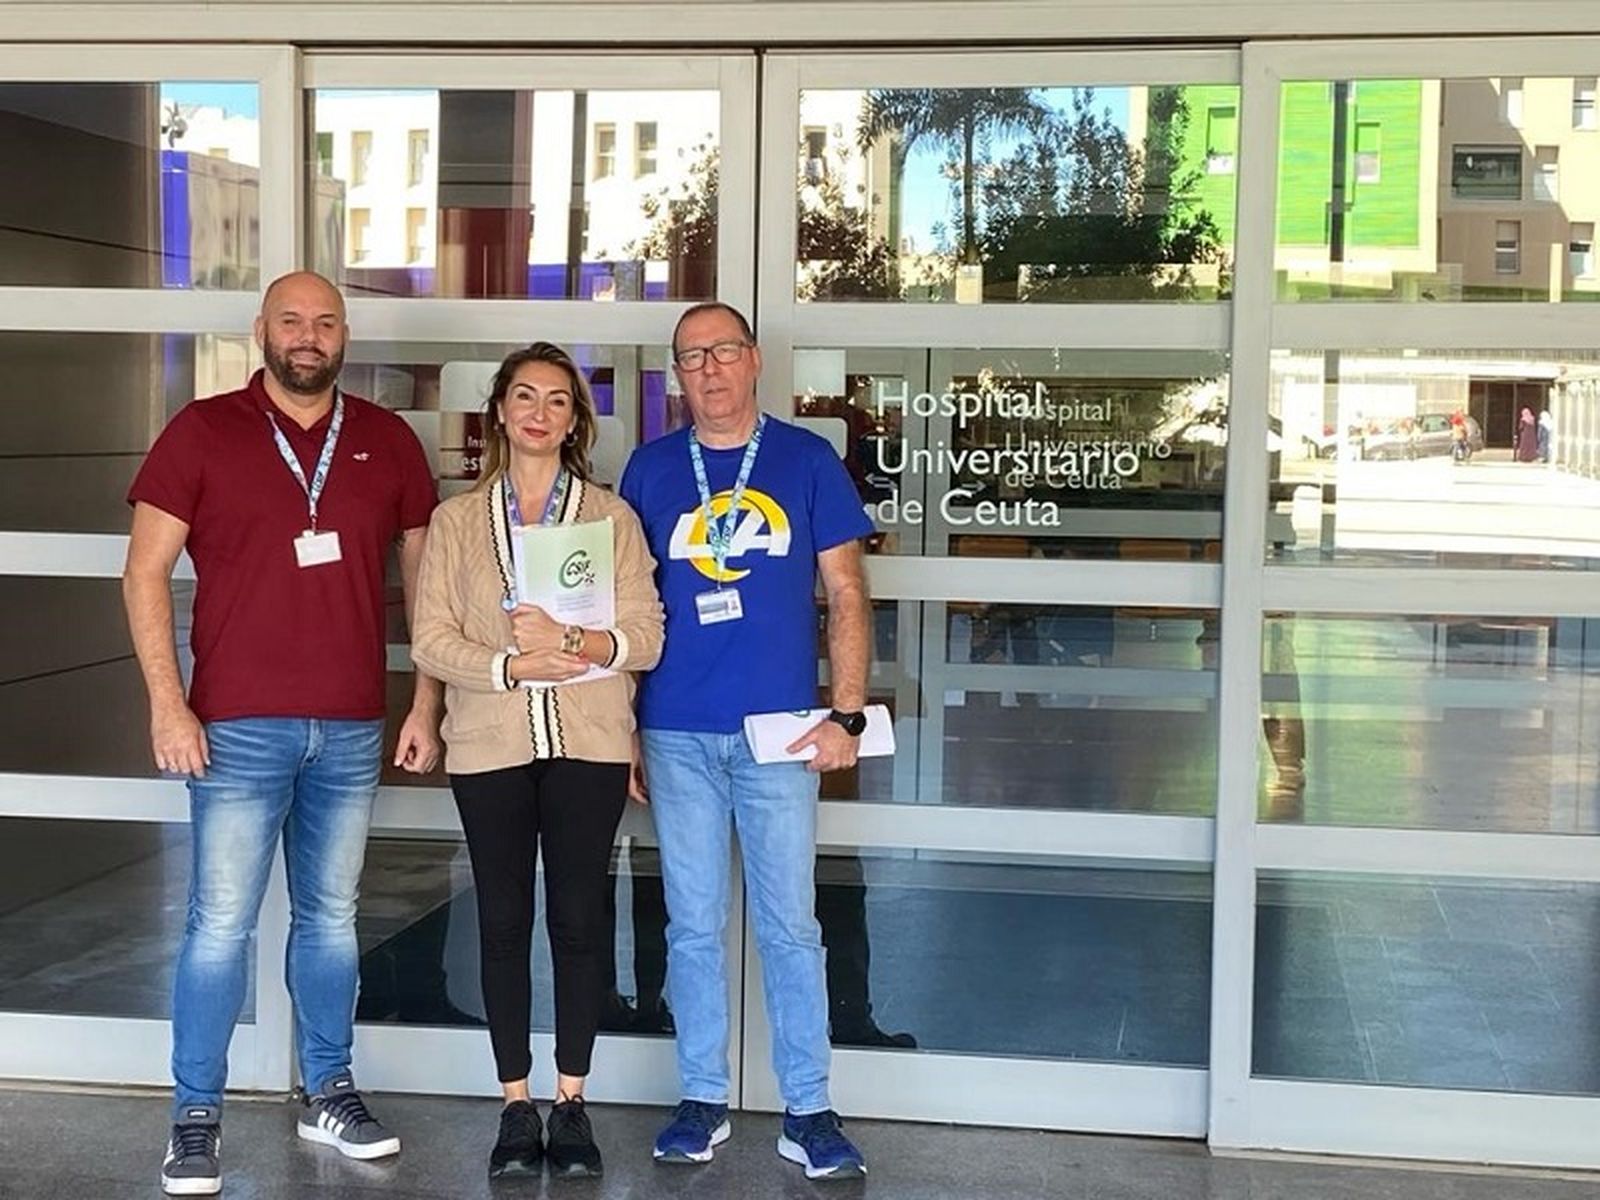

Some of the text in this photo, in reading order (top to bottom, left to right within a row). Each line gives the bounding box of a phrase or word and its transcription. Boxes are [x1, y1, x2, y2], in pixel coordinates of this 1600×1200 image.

[878, 381, 1042, 428] Hospital
[877, 438, 1139, 477] Universitario
[877, 489, 1061, 526] de Ceuta
